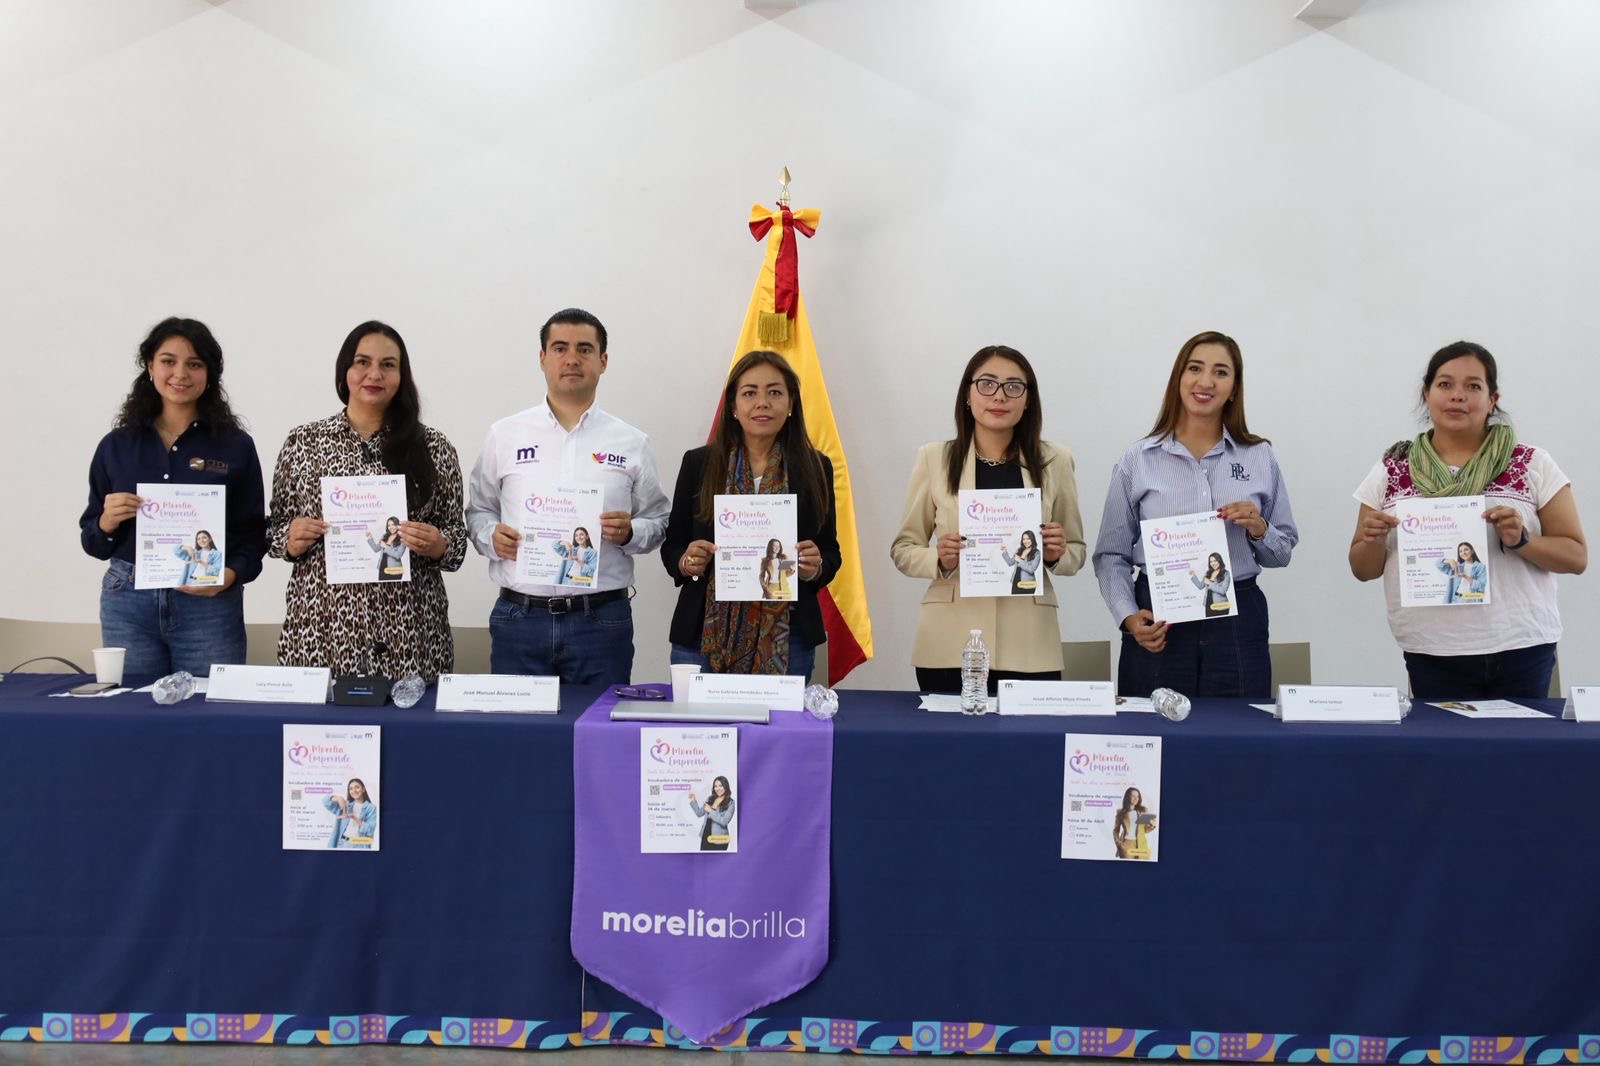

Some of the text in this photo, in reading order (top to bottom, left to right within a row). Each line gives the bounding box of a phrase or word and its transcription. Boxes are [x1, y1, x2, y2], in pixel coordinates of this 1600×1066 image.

[608, 453, 627, 464] DIF
[312, 744, 344, 754] Morelia
[672, 746, 704, 756] Morelia
[308, 754, 351, 764] Emprende
[668, 757, 710, 768] Emprende
[1092, 753, 1125, 763] Morelia
[1089, 763, 1131, 774] Emprende
